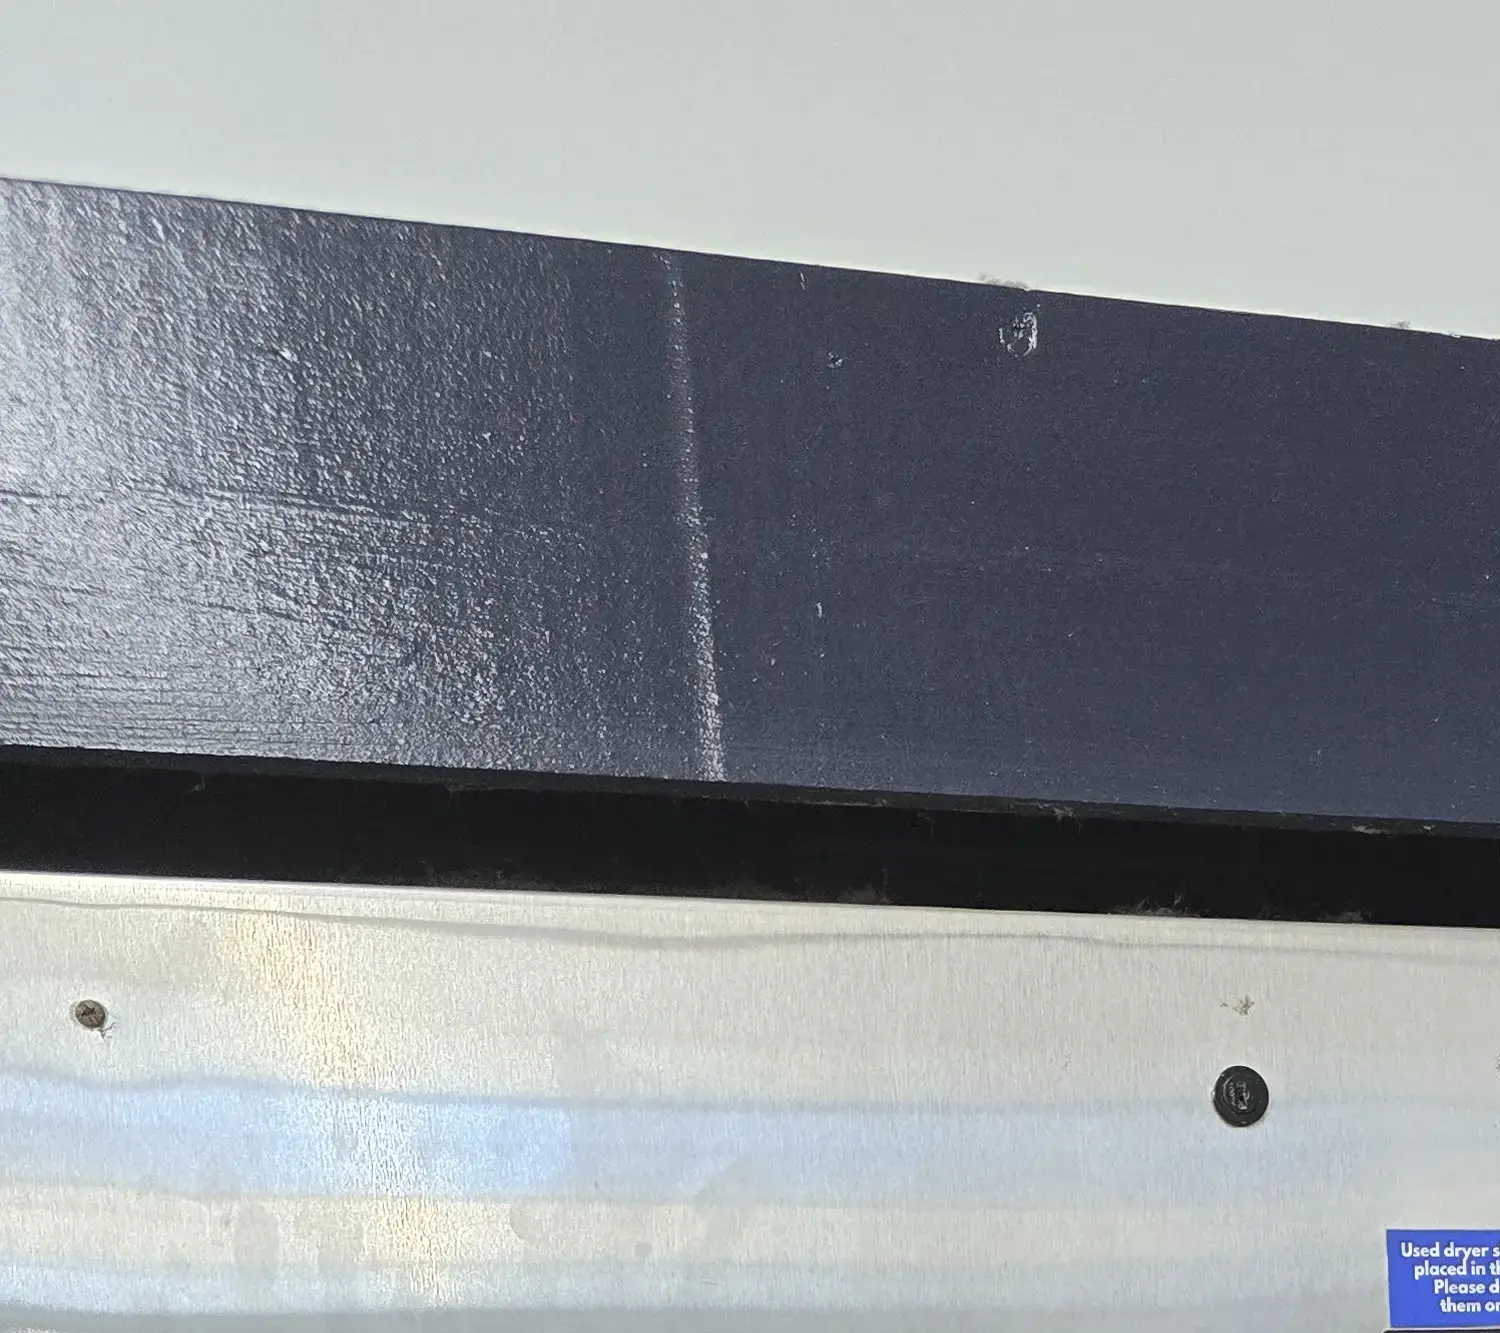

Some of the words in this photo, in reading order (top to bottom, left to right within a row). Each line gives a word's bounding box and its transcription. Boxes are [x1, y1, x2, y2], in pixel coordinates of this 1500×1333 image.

[1401, 1242, 1439, 1257] Used
[1444, 1242, 1488, 1261] dryer
[1414, 1260, 1466, 1279] placed
[1470, 1260, 1486, 1275] in
[1434, 1279, 1485, 1294] Please
[1440, 1298, 1481, 1312] them
